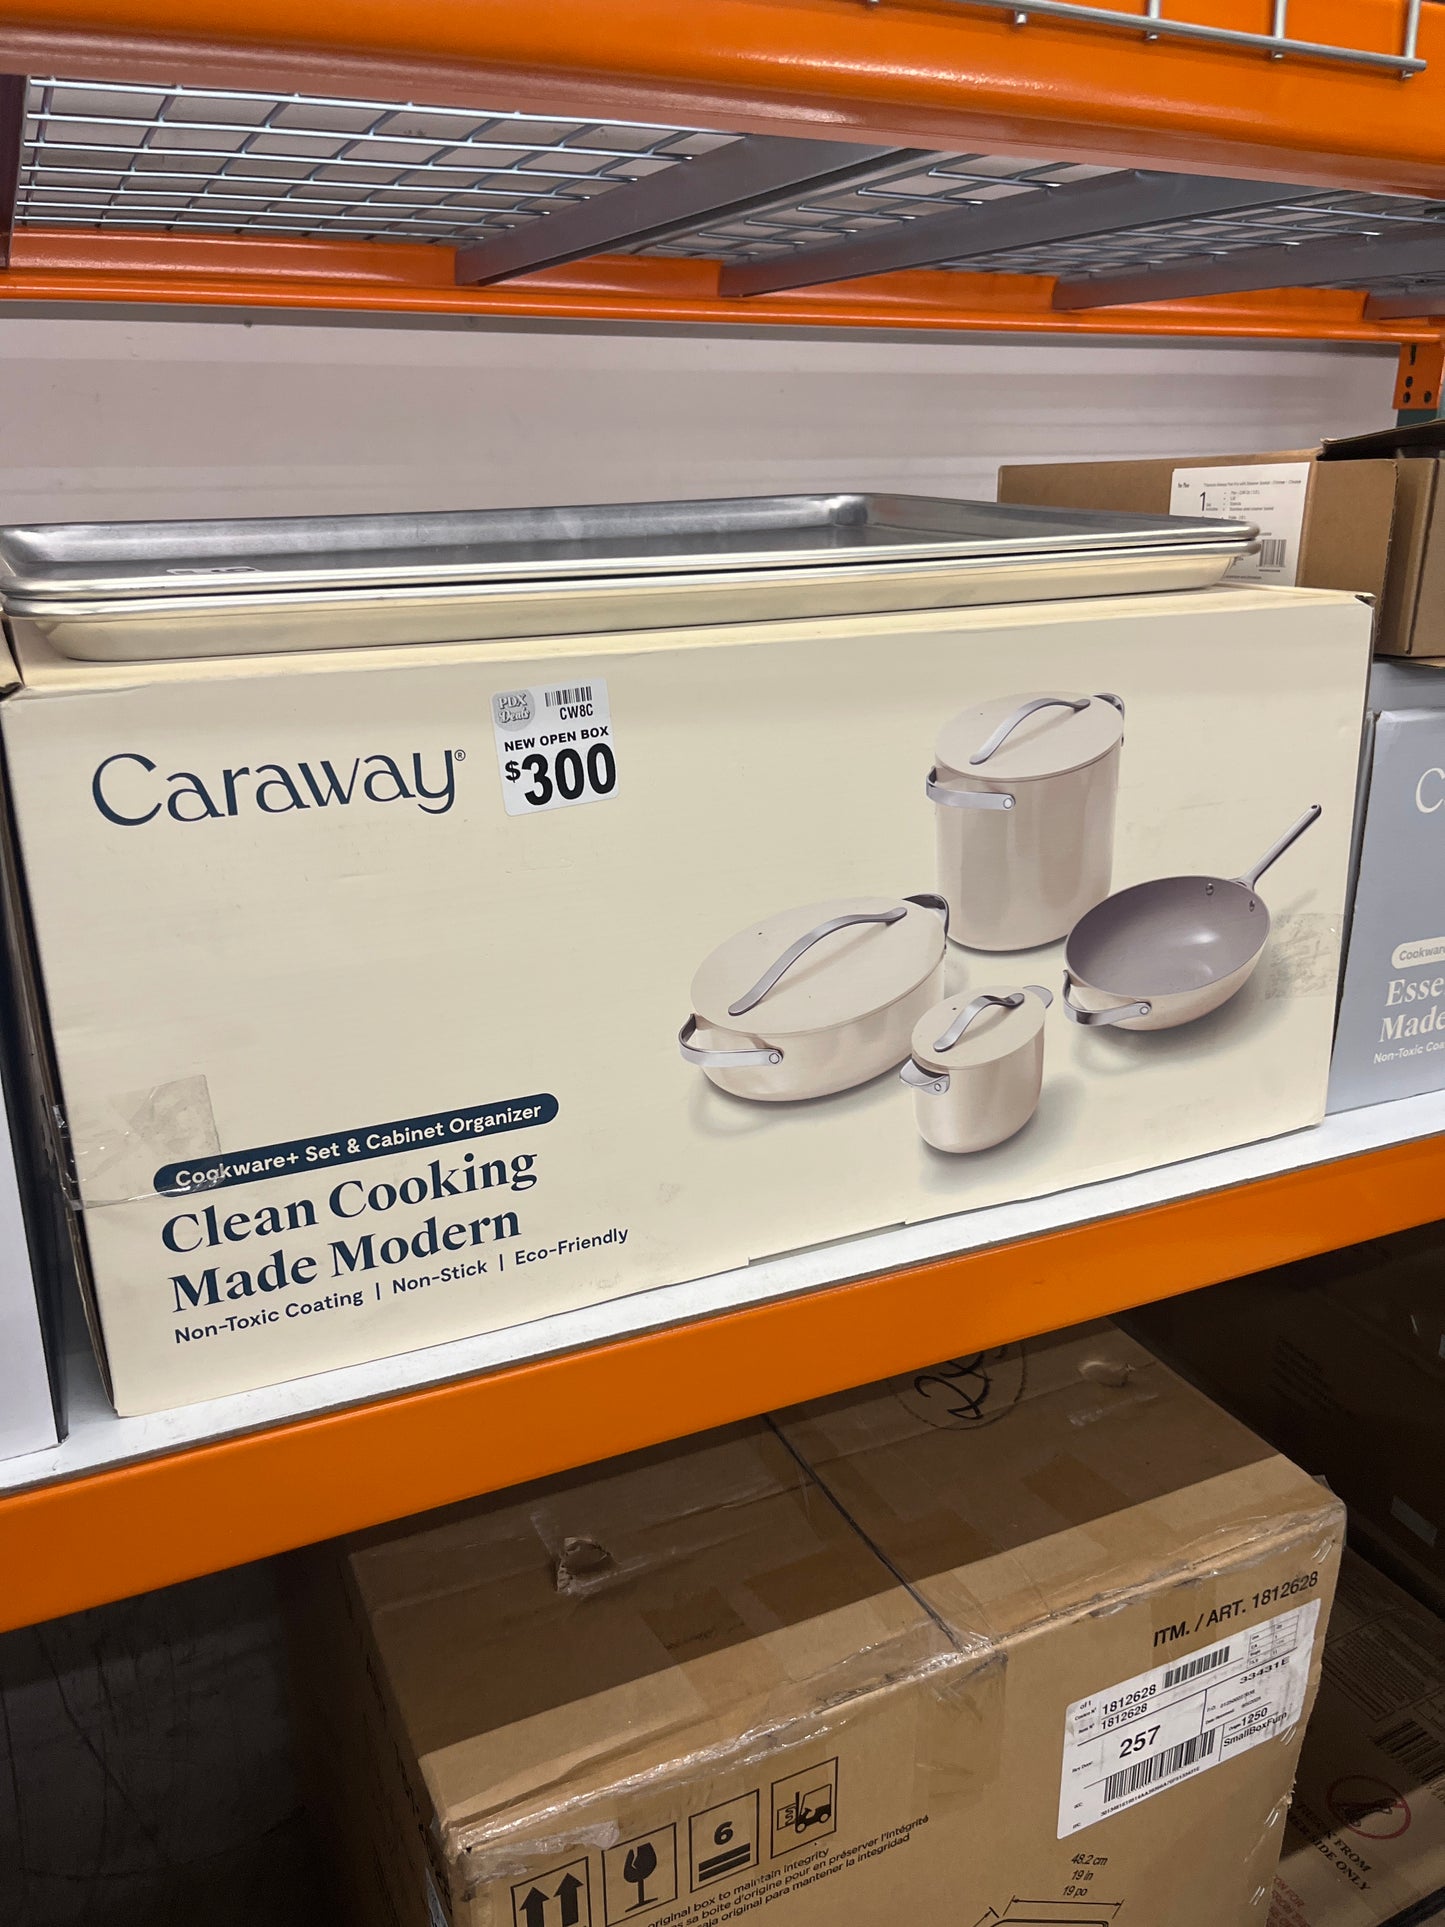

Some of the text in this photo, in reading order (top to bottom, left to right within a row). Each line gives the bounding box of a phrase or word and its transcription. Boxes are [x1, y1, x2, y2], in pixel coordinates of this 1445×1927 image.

[498, 693, 528, 710] PDX
[498, 707, 531, 724] Deals
[559, 703, 594, 720] CW8C
[504, 726, 609, 752] NEW OPEN BOX
[505, 743, 616, 806] $300
[1398, 946, 1445, 961] Cookwar
[1384, 977, 1445, 1007] Esse
[1378, 1005, 1445, 1043] Made
[1373, 1040, 1445, 1064] Non-Toxic Coa
[174, 1103, 542, 1188] Cookware+ Set & Cabinet Organizer
[161, 1151, 538, 1254] Clean Cooking
[168, 1209, 522, 1313] Made Modern
[174, 1309, 280, 1344] Non-Toxic
[285, 1288, 364, 1320] Coating
[392, 1259, 489, 1295] Non-Stick
[514, 1226, 629, 1266] Eco-Friendly
[1153, 1622, 1190, 1647] ITM.
[1206, 1600, 1246, 1627] ART.
[1252, 1570, 1319, 1609] 1812628
[1239, 1656, 1291, 1684] 33431E
[1102, 1684, 1157, 1715] 1812628
[1101, 1703, 1148, 1730] 1812628
[1223, 1711, 1288, 1747] SmallBoxFurn
[1119, 1724, 1161, 1758] 257
[713, 1820, 734, 1846] 6
[1071, 1853, 1108, 1866] 48.2 cm
[1334, 1838, 1372, 1873] FROM
[686, 1915, 699, 1925] sa
[734, 1880, 782, 1905] d'origine
[784, 1868, 811, 1887] pour
[813, 1861, 826, 1872] en
[828, 1838, 879, 1869] préserver
[693, 1897, 715, 1911] box
[719, 1890, 731, 1900] to
[733, 1868, 781, 1896] maintain
[783, 1847, 829, 1873] integrity
[721, 1897, 763, 1921] original
[765, 1887, 790, 1904] para
[792, 1864, 844, 1890] mantener
[845, 1856, 855, 1869] la
[857, 1832, 910, 1863] integridad
[1071, 1869, 1094, 1881] 19 in
[1335, 1860, 1372, 1891] ONLY
[1062, 1885, 1087, 1898] 19 po
